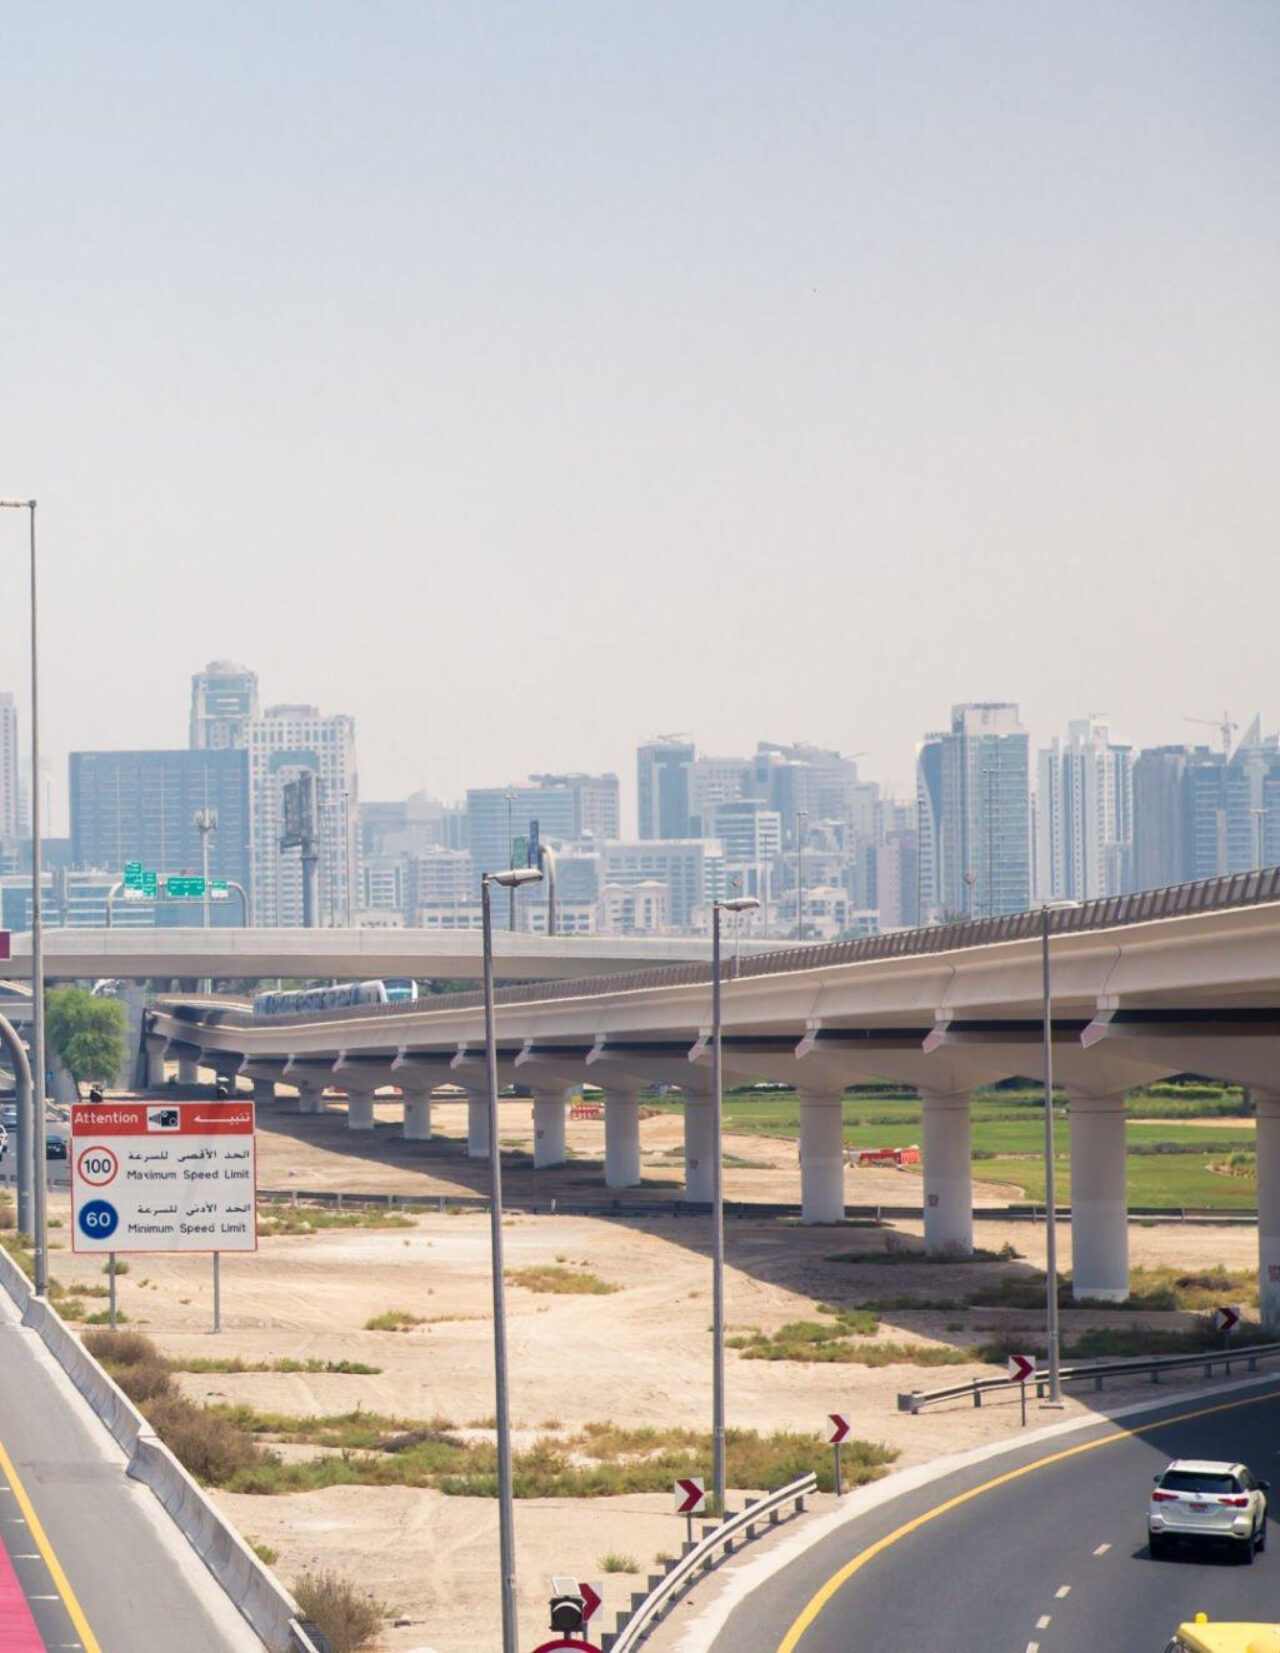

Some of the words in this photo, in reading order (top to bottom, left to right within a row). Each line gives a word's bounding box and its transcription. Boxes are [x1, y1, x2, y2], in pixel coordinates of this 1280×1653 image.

[74, 1111, 138, 1125] Attention
[128, 1150, 169, 1163] للسرعة
[224, 1150, 250, 1160] الحد
[83, 1158, 112, 1174] 100
[126, 1169, 177, 1180] Maximum
[183, 1169, 219, 1181] Speed
[224, 1169, 250, 1179] Limit
[137, 1204, 178, 1216] للسرعة
[225, 1203, 251, 1213] الحد
[85, 1212, 111, 1227] 60
[127, 1223, 174, 1234] Minimum
[180, 1223, 215, 1235] Speed
[220, 1223, 246, 1233] Limit
